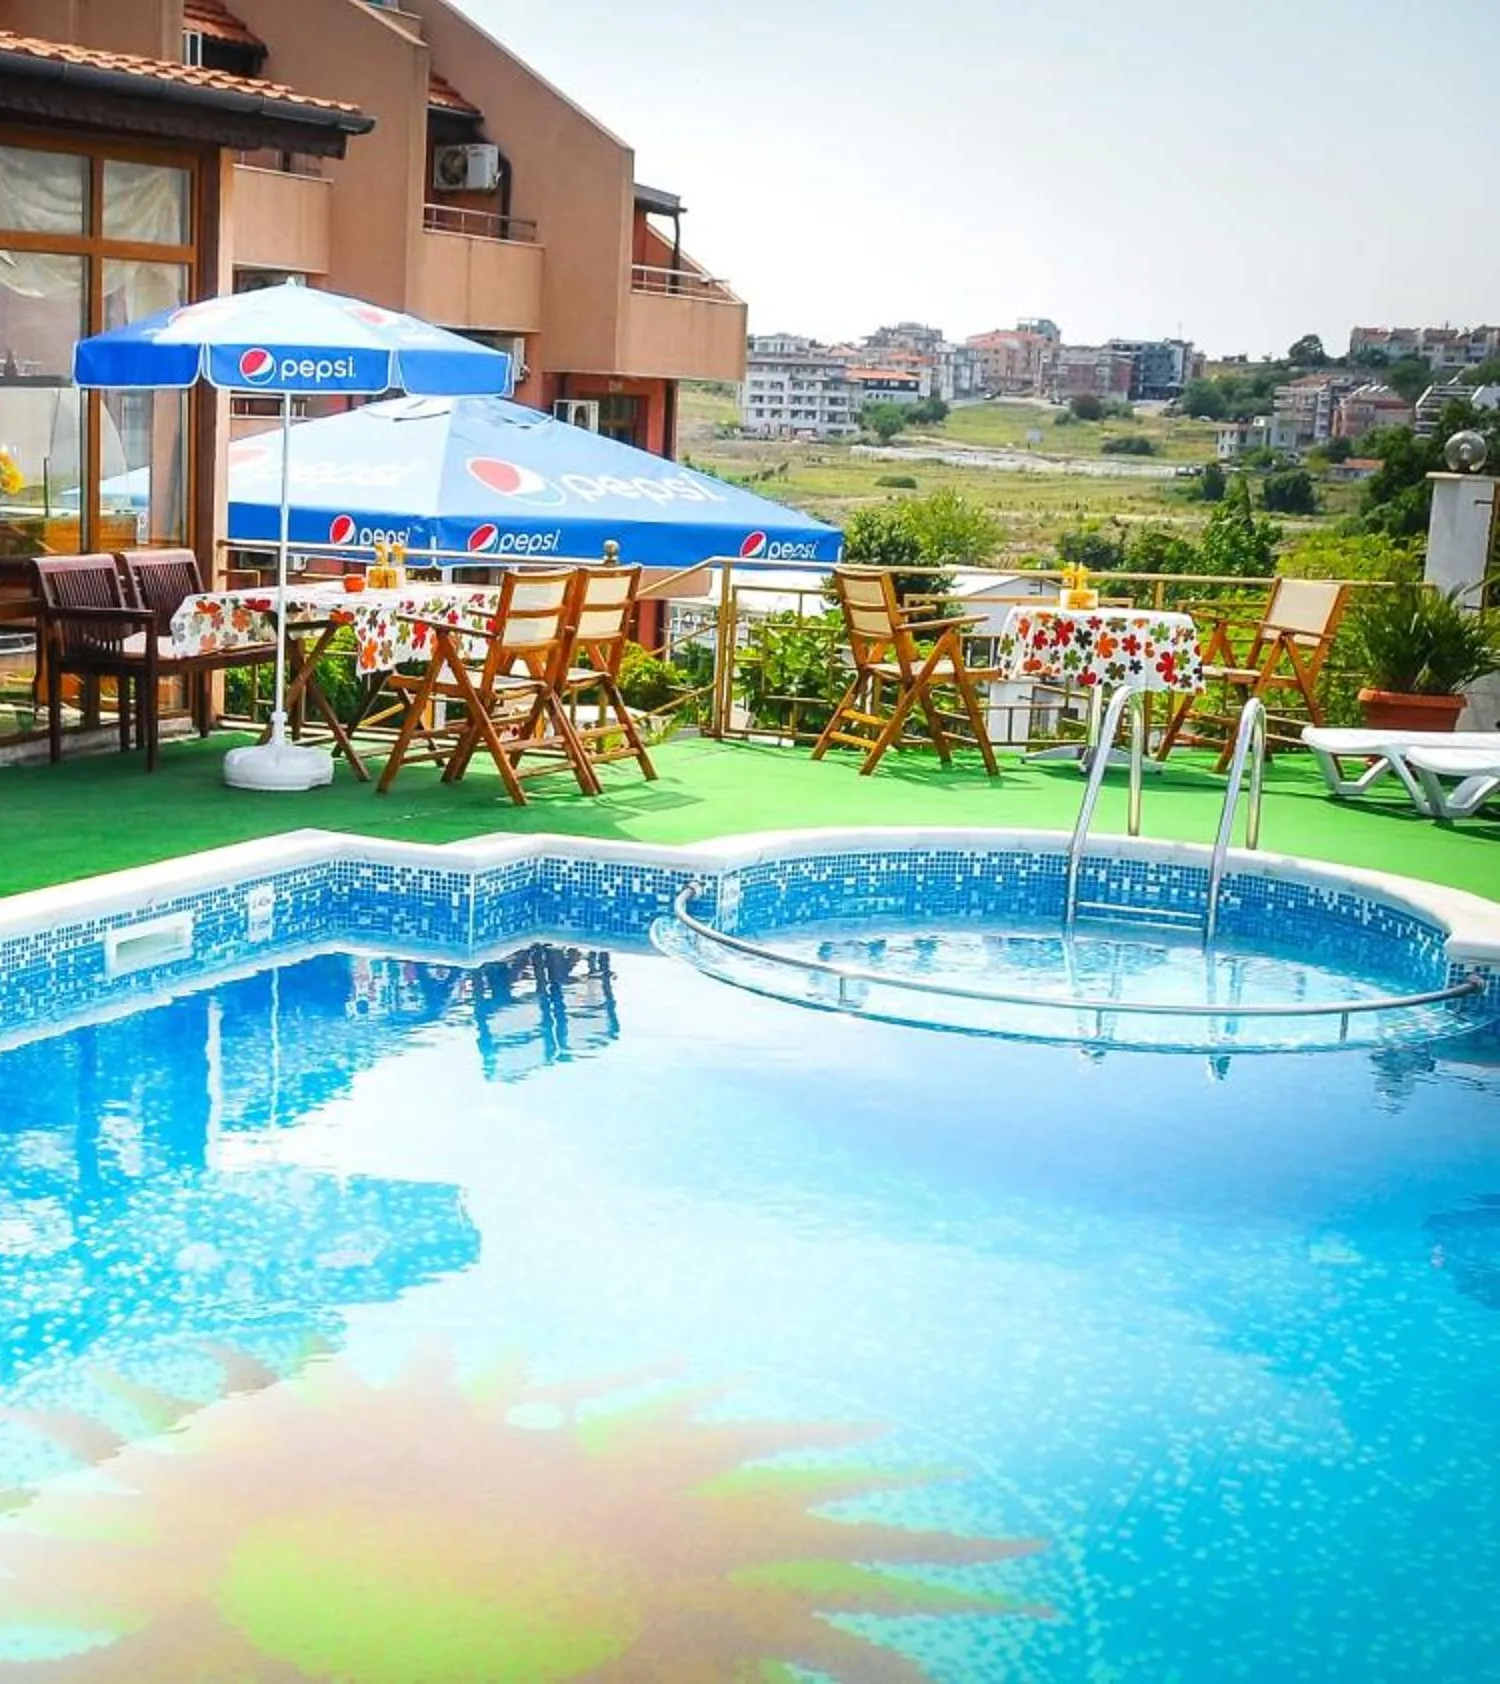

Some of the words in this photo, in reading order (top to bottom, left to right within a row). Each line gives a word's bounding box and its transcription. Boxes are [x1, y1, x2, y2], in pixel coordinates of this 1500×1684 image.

[281, 356, 353, 382] pepsi
[561, 463, 718, 507] pepsi
[500, 529, 560, 554] pepsi
